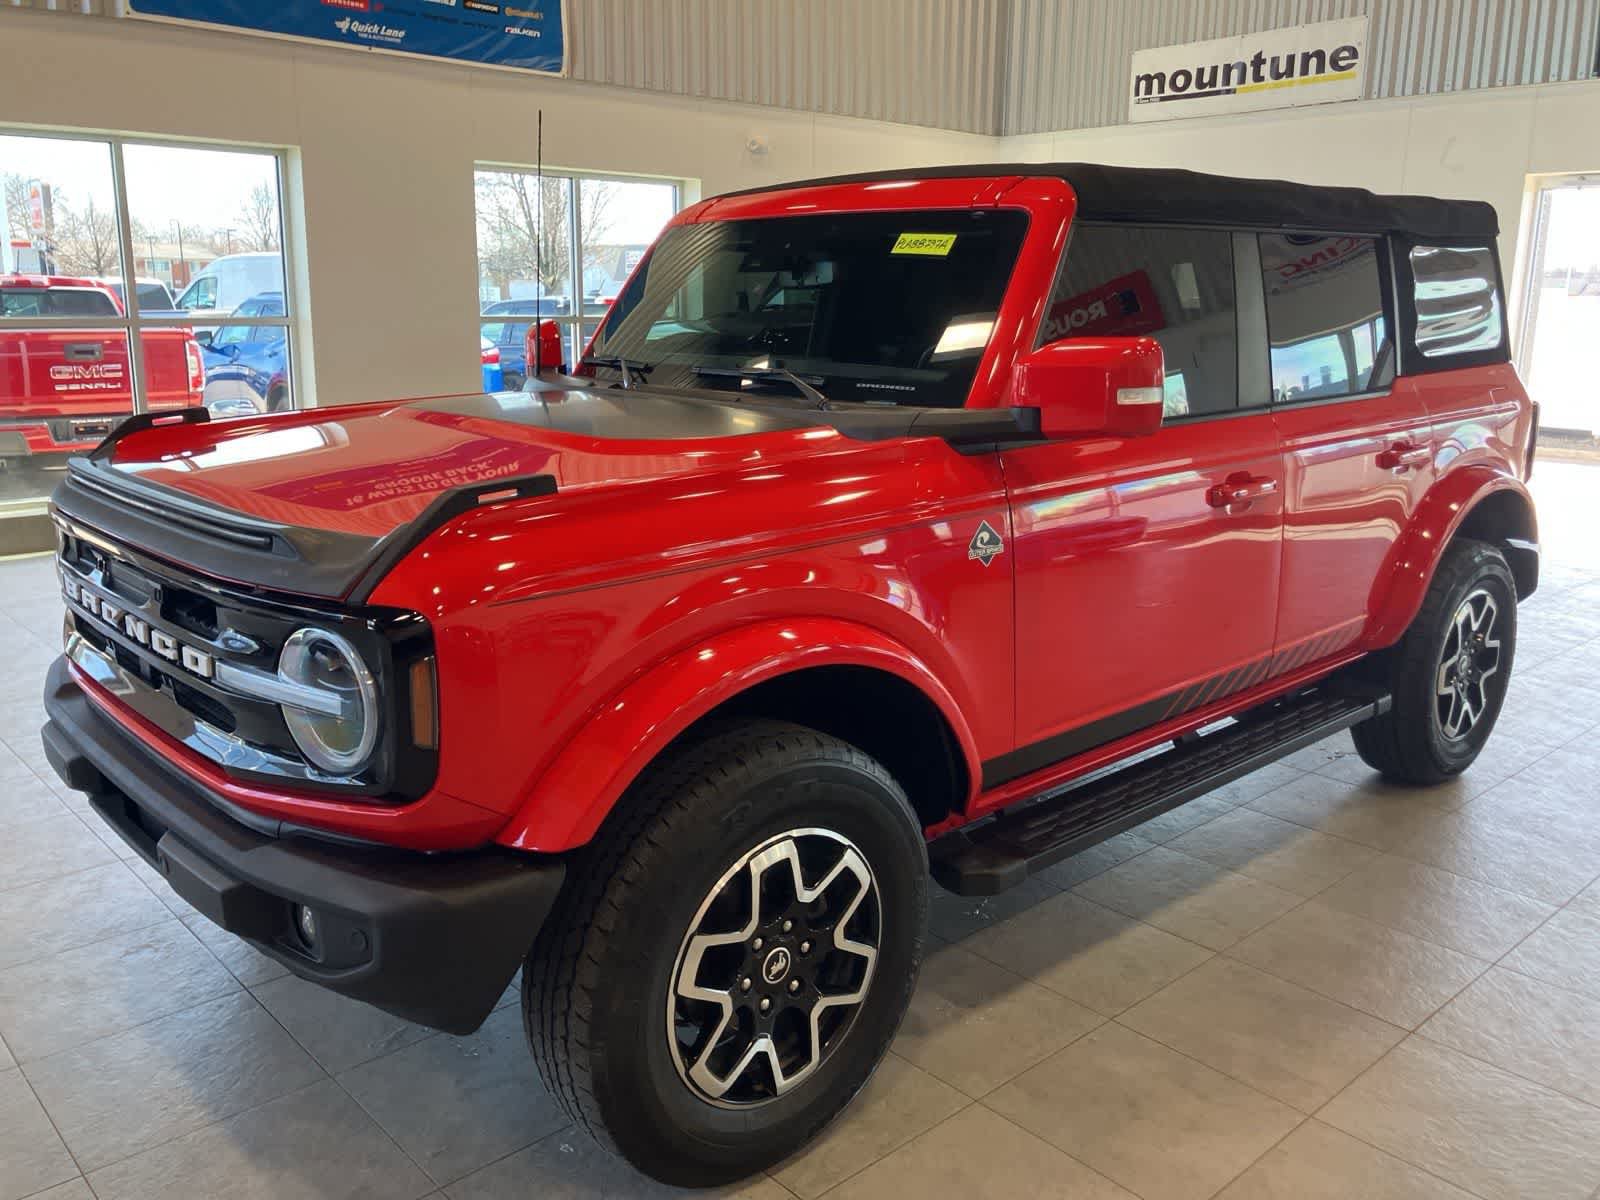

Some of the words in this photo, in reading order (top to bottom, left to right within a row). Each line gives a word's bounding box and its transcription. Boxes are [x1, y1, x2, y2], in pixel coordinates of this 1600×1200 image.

[350, 20, 380, 34] Quick
[380, 25, 406, 38] Lane
[1133, 45, 1359, 97] mountune
[50, 363, 123, 380] GMC
[63, 574, 213, 678] BRONCO
